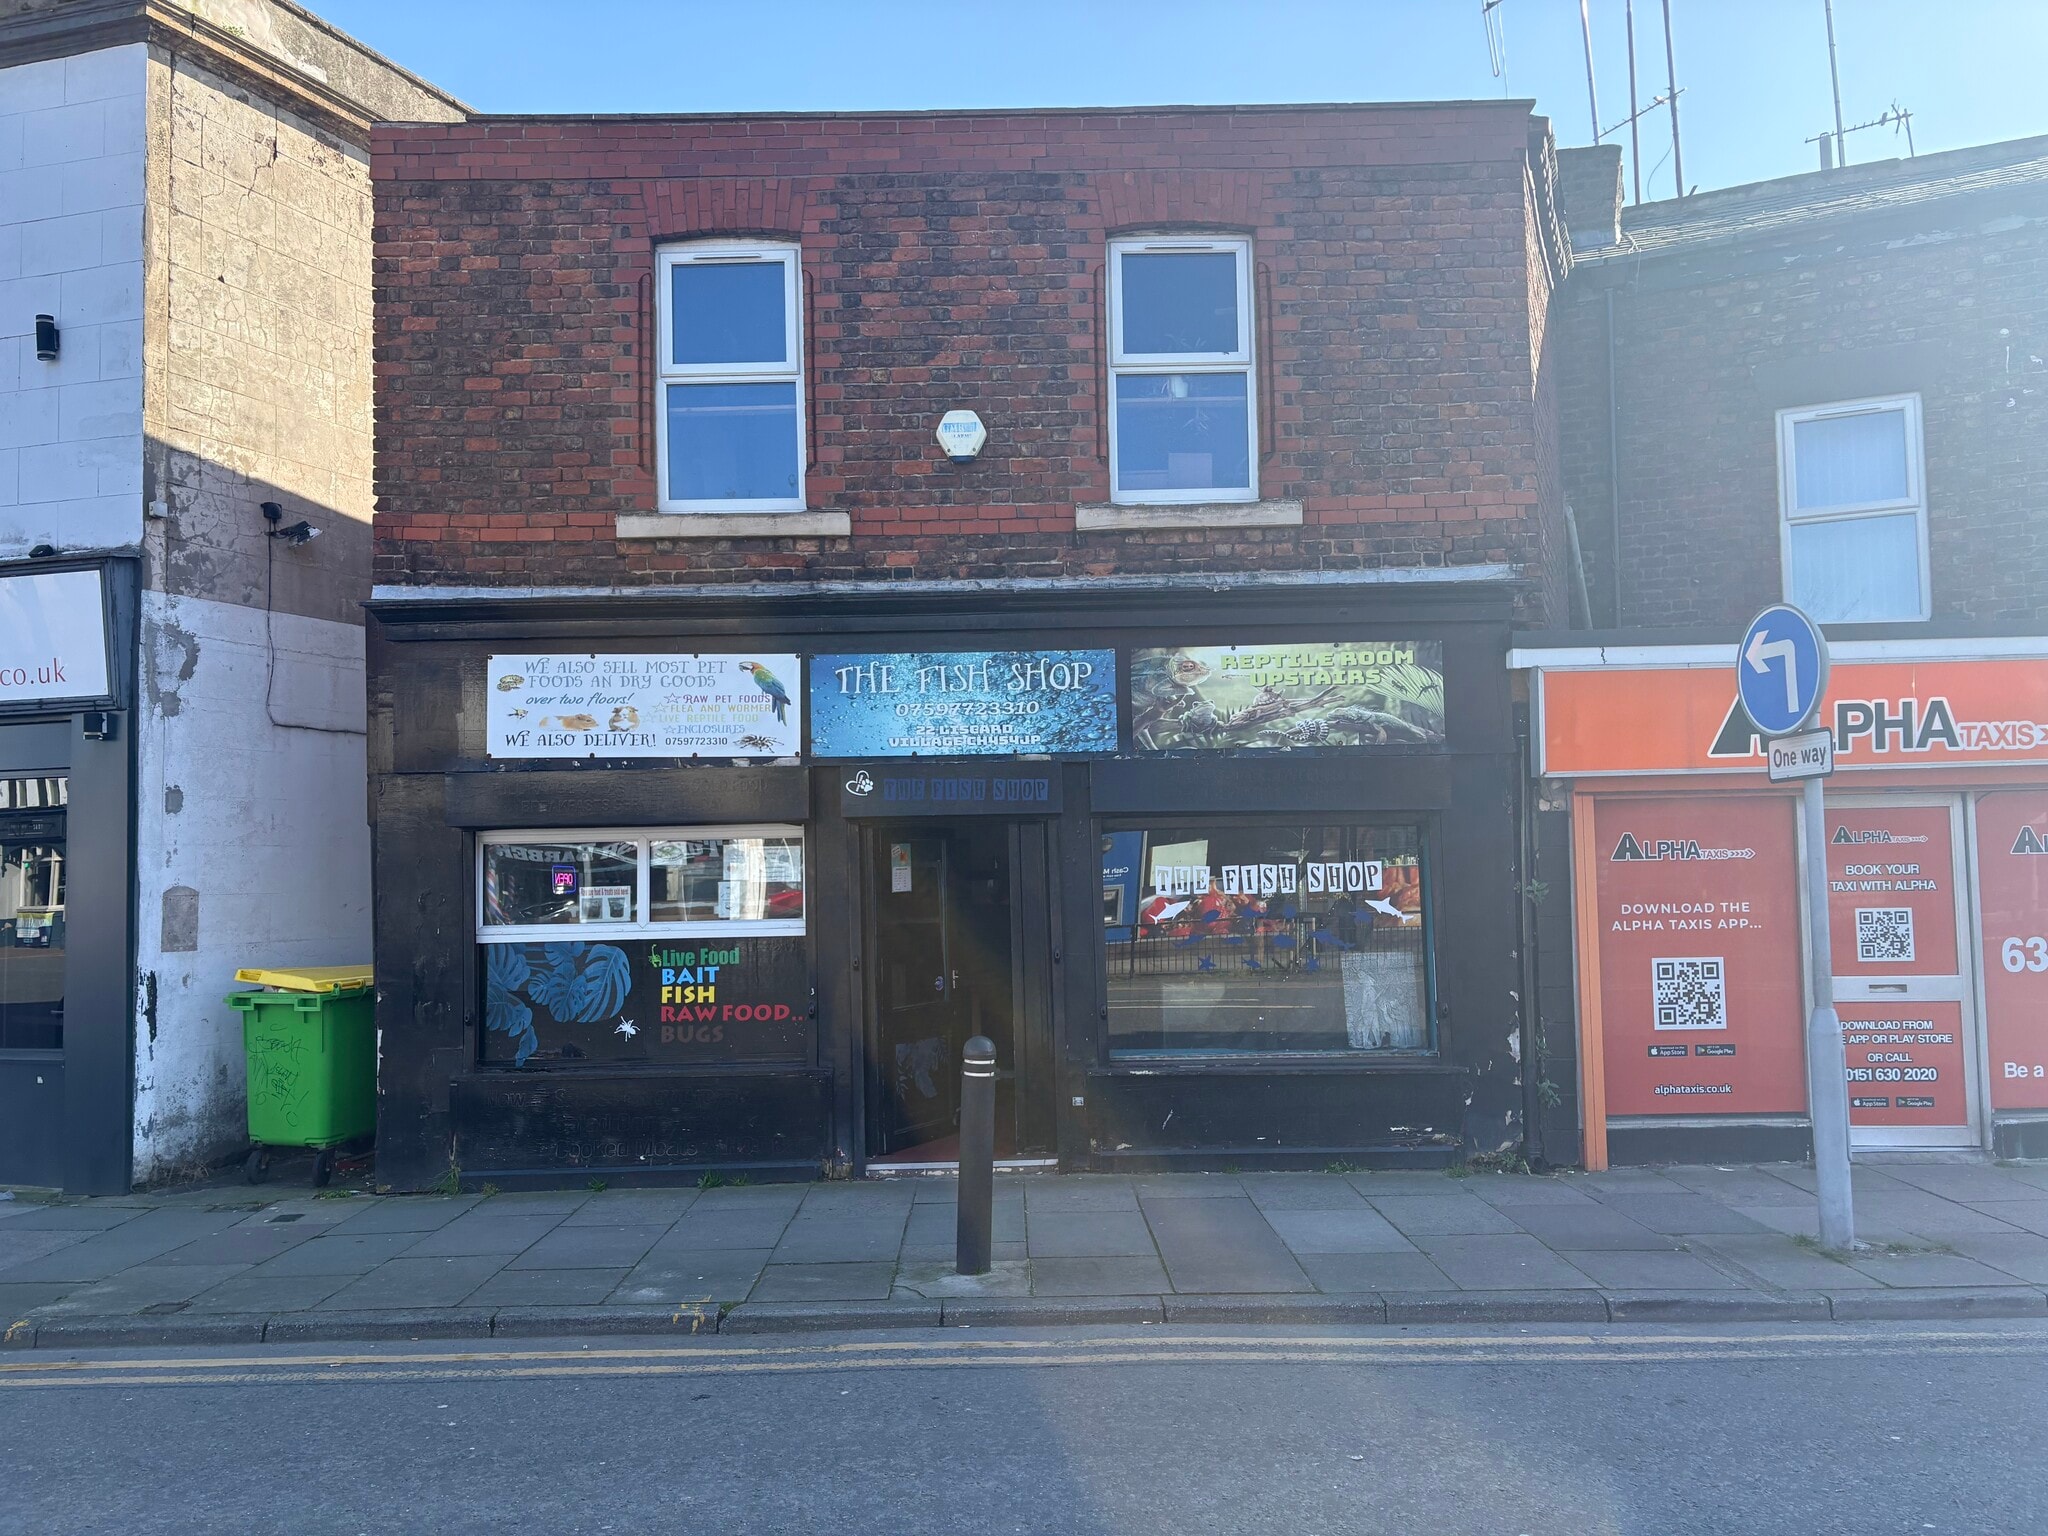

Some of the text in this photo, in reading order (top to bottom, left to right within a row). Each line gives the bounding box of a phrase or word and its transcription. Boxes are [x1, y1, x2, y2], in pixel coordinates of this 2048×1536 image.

[525, 657, 728, 674] WE ALSO SELL MOST PET
[1221, 650, 1415, 670] REPTILE ROOM
[0, 657, 67, 686] co.uk
[836, 658, 1092, 695] THE FISH SHOP
[1250, 669, 1383, 687] UPSTAIRS
[529, 675, 716, 689] FOODS AN DRY GOODS
[525, 692, 635, 707] over two floors!
[683, 694, 771, 704] RAW PET FOODS
[670, 704, 771, 713] FLEA AND WORMER
[895, 701, 1040, 717] 07597723310
[660, 714, 759, 722] LIVE REPTILE FOOD
[1708, 694, 2035, 757] APHA TAXIS
[677, 724, 746, 734] ENCLOSURES
[505, 730, 656, 748] WE ALSO DELIVER!
[665, 737, 728, 746] 07597723310
[1773, 746, 1827, 768] One way
[884, 778, 1049, 800] THE FISH SHOP
[1832, 827, 1892, 844] ALPHA
[1611, 833, 1729, 860] ALPHA TAXIS
[1845, 864, 1920, 875] BOOK YOUR
[1157, 864, 1381, 894] THE FISH SHOP
[1830, 880, 1937, 891] TAXI WITH ALPHA
[1621, 902, 1750, 915] DOWNLOAD THE
[1612, 918, 1762, 931] ALPHA TAXIS APP...
[662, 947, 740, 967] Live Food
[661, 966, 720, 985] BAIT
[661, 985, 715, 1004] FISH
[660, 1005, 718, 1022] RAW
[1841, 1020, 1933, 1030] DOWNLOAD FROM
[661, 1024, 724, 1043] BUGS
[1848, 1035, 1870, 1044] APP
[1871, 1035, 1888, 1043] OR
[1889, 1034, 1915, 1044] PLAY
[1918, 1034, 1953, 1043] STORE
[1867, 1052, 1913, 1062] OR CALL
[1846, 1068, 1937, 1081] 0151 630 2020
[2004, 1062, 2045, 1078] Be a
[1654, 1083, 1732, 1096] alphataxis.co.uk
